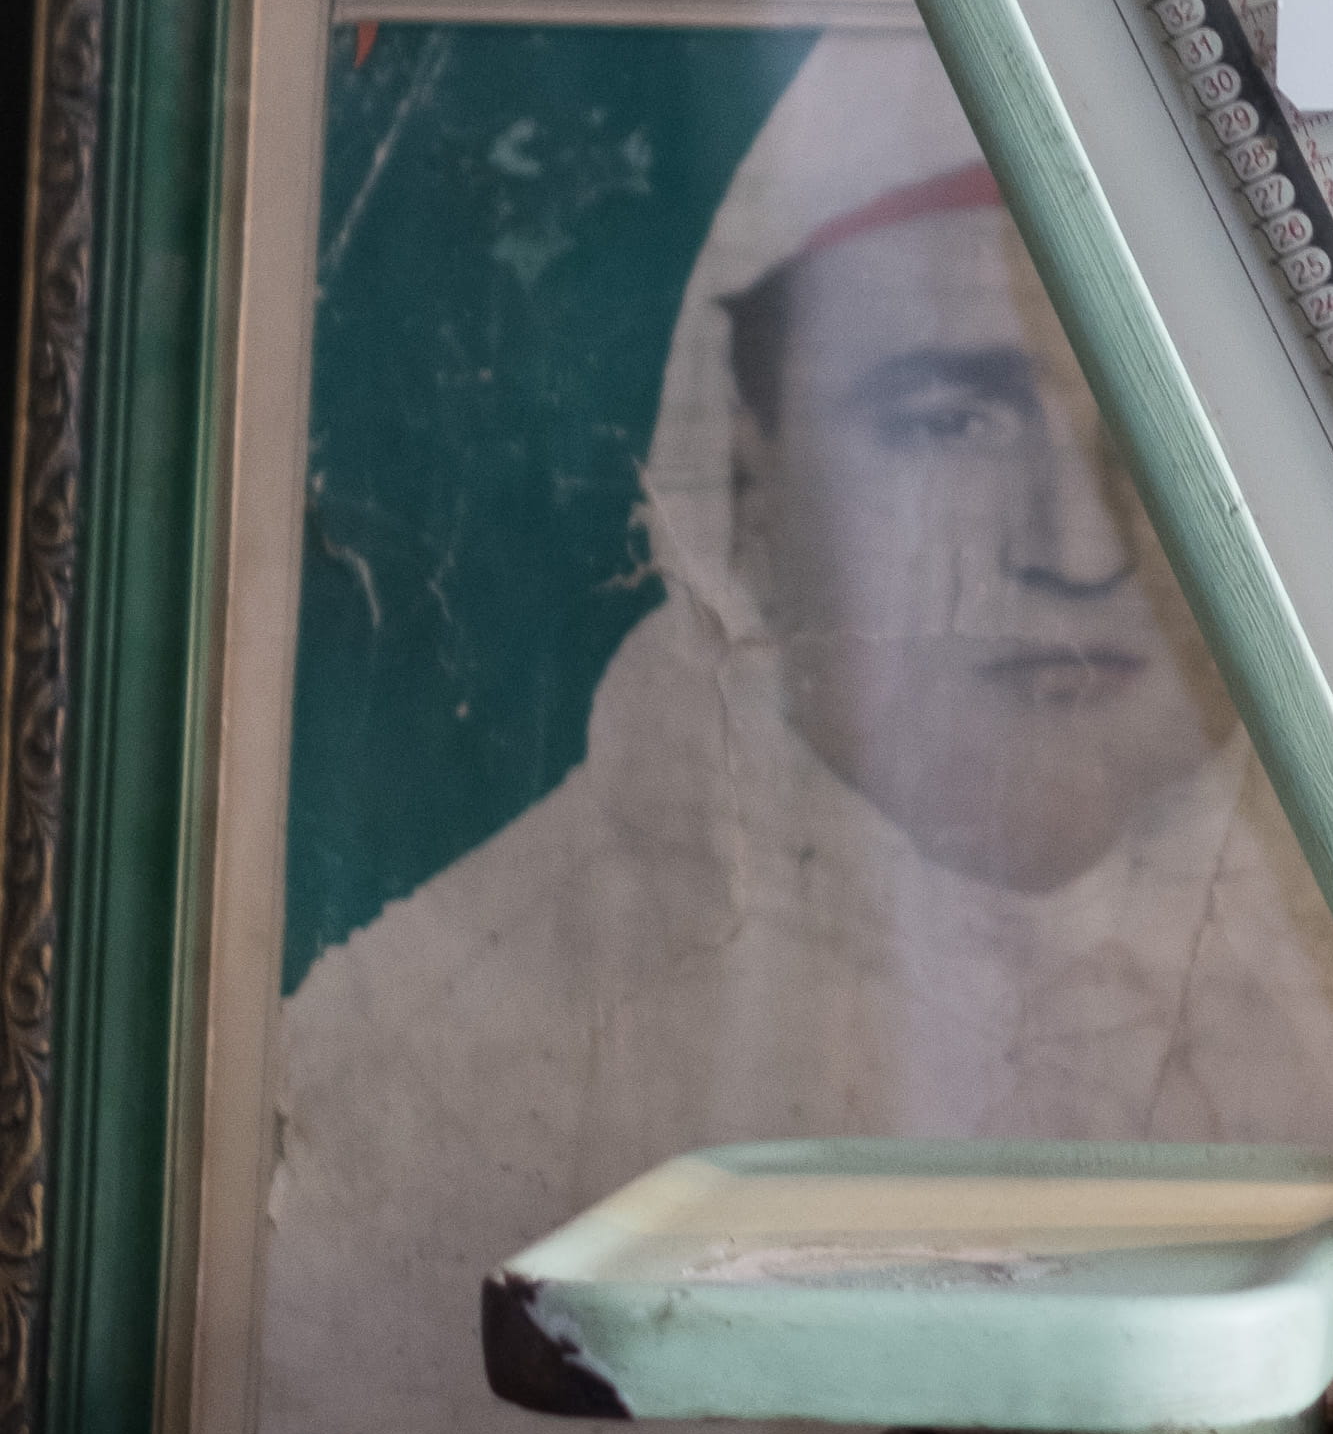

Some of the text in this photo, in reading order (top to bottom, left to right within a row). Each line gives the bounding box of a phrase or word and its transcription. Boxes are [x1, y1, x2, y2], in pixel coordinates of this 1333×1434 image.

[1184, 34, 1215, 64] 31
[1202, 68, 1234, 100] 30
[1218, 107, 1251, 140] 29
[1236, 143, 1270, 174] 28
[1255, 180, 1283, 214] 27
[1273, 215, 1307, 248] 26
[1291, 254, 1325, 284] 25
